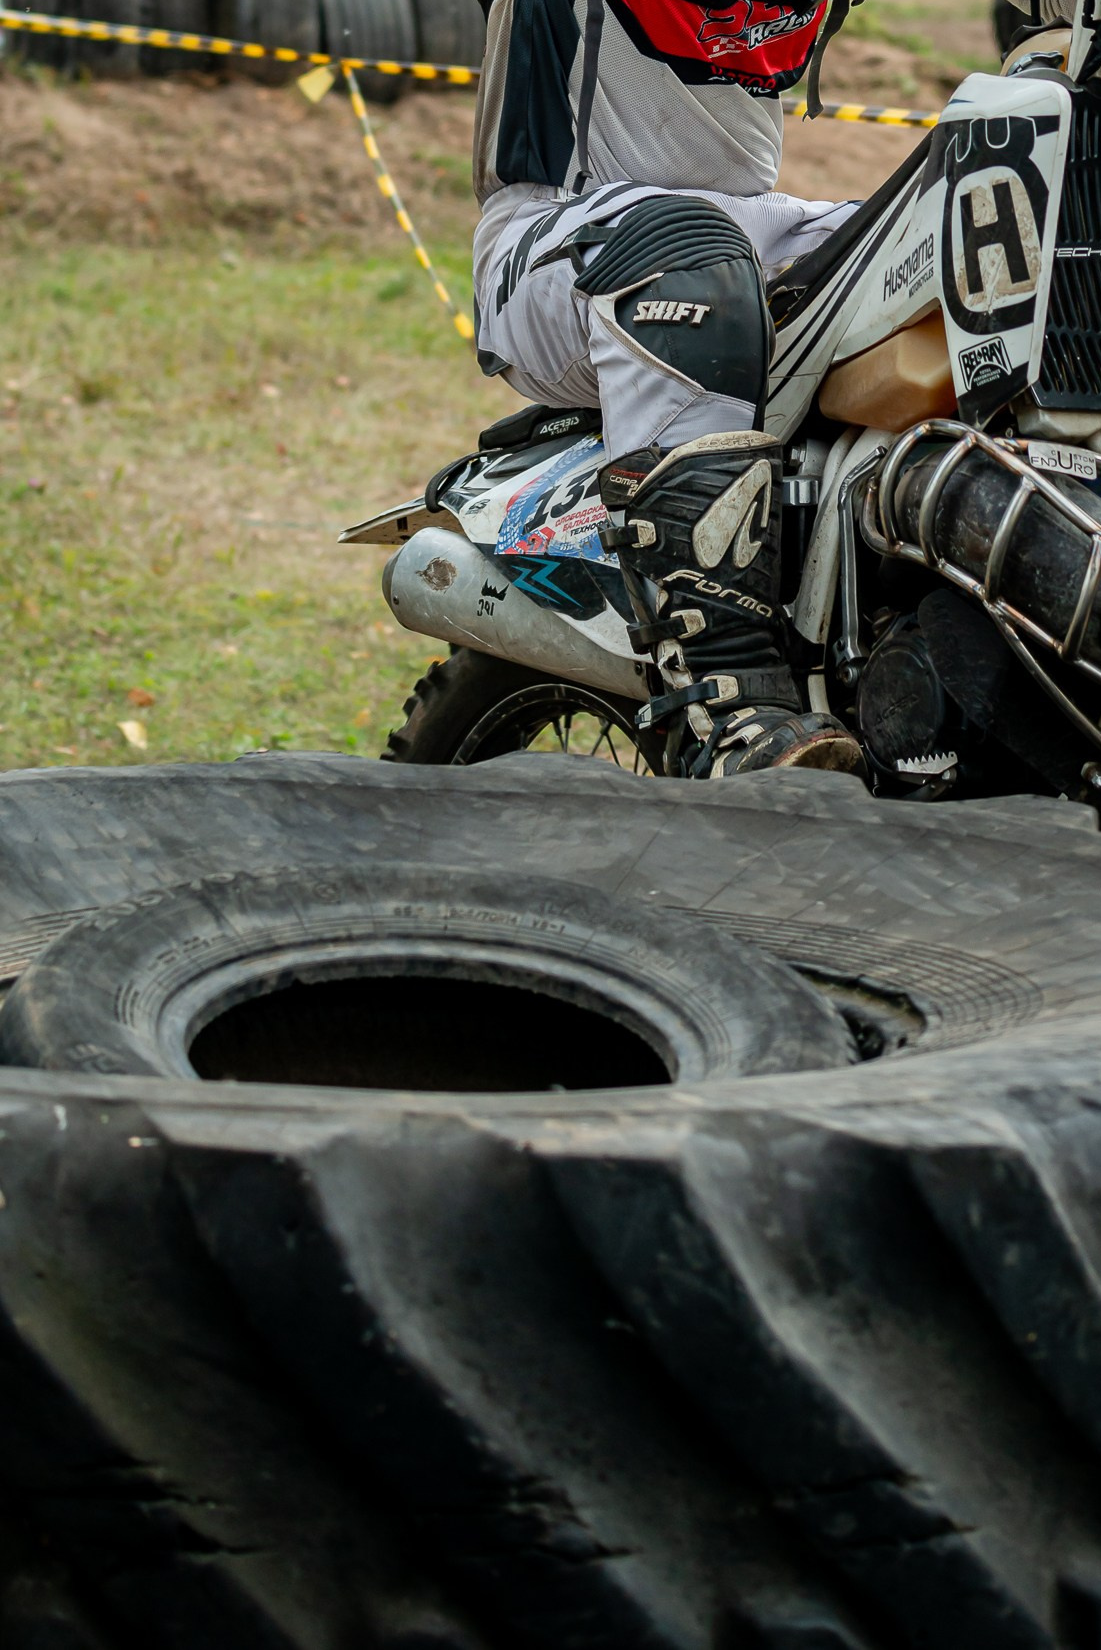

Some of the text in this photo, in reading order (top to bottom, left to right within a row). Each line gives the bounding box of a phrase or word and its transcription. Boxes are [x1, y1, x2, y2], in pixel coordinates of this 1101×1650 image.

[883, 233, 934, 302] Husqvarna
[909, 266, 934, 299] MOTORCYCLES
[633, 301, 711, 326] SHIFT
[1031, 450, 1094, 476] ENDURO
[555, 503, 606, 527] СЛОБОДСКА
